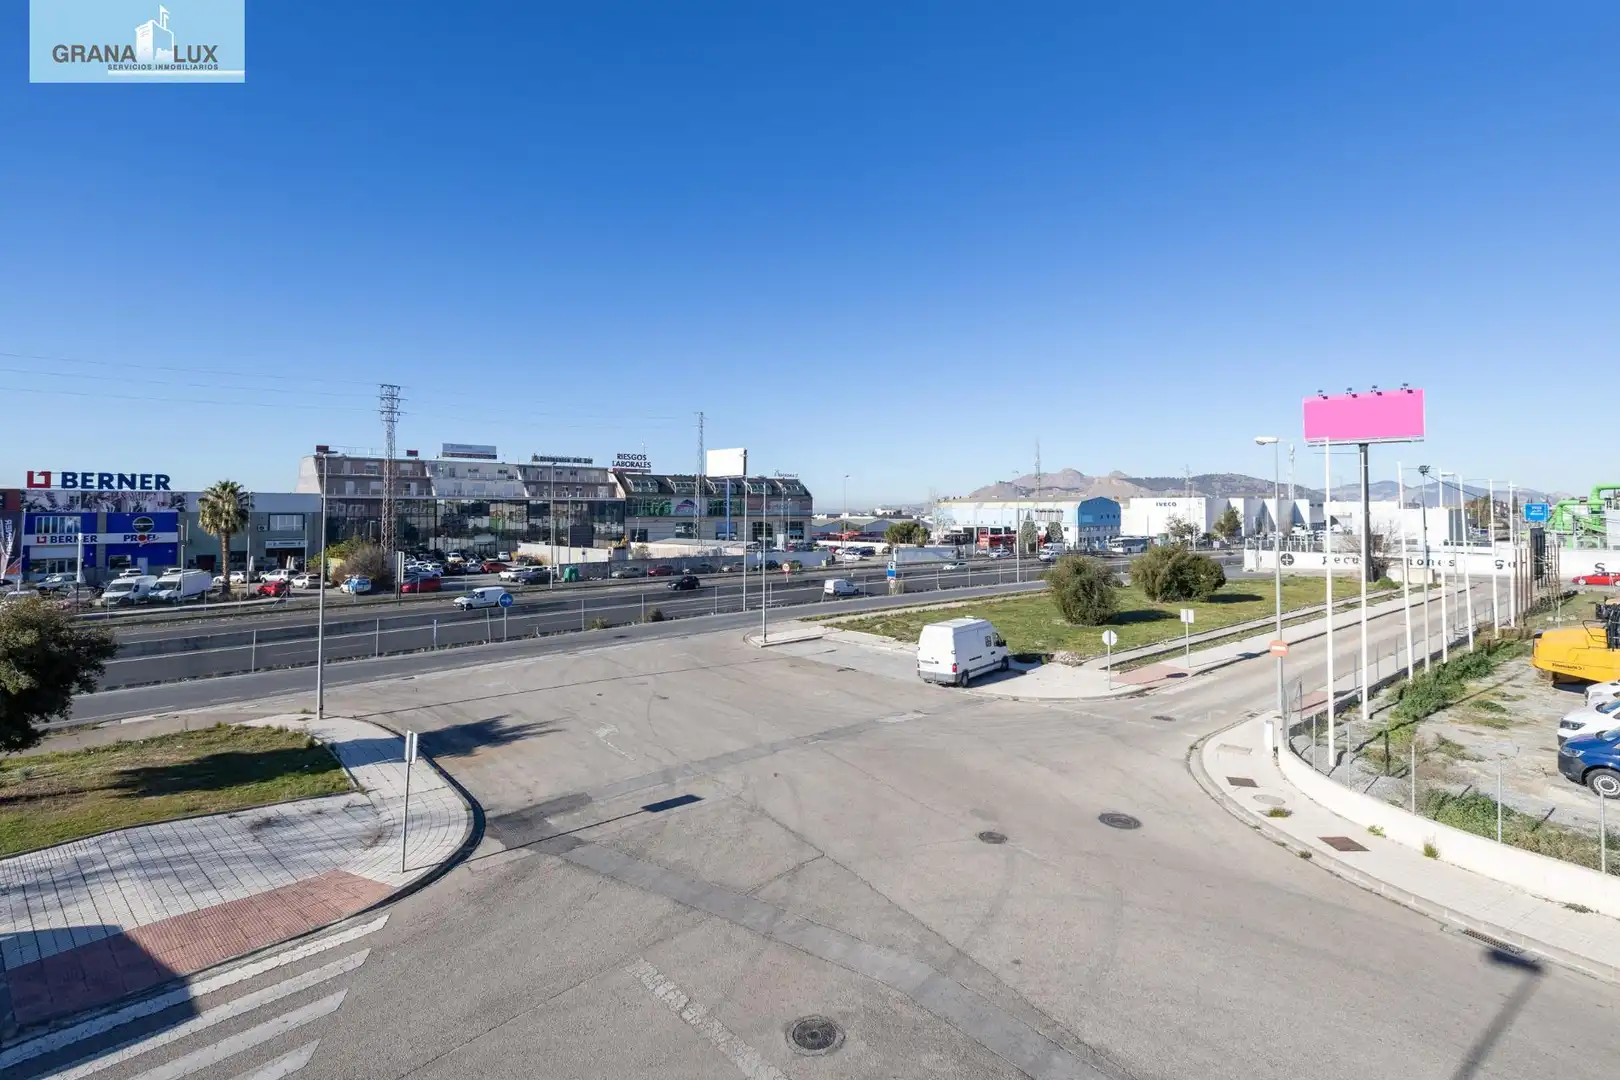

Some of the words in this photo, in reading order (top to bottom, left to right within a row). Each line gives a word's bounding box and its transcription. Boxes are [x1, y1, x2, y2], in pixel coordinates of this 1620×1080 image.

[616, 453, 647, 461] RIESGOS
[612, 460, 652, 468] LABORALES
[61, 471, 171, 490] BERNER
[50, 535, 98, 543] BERNER
